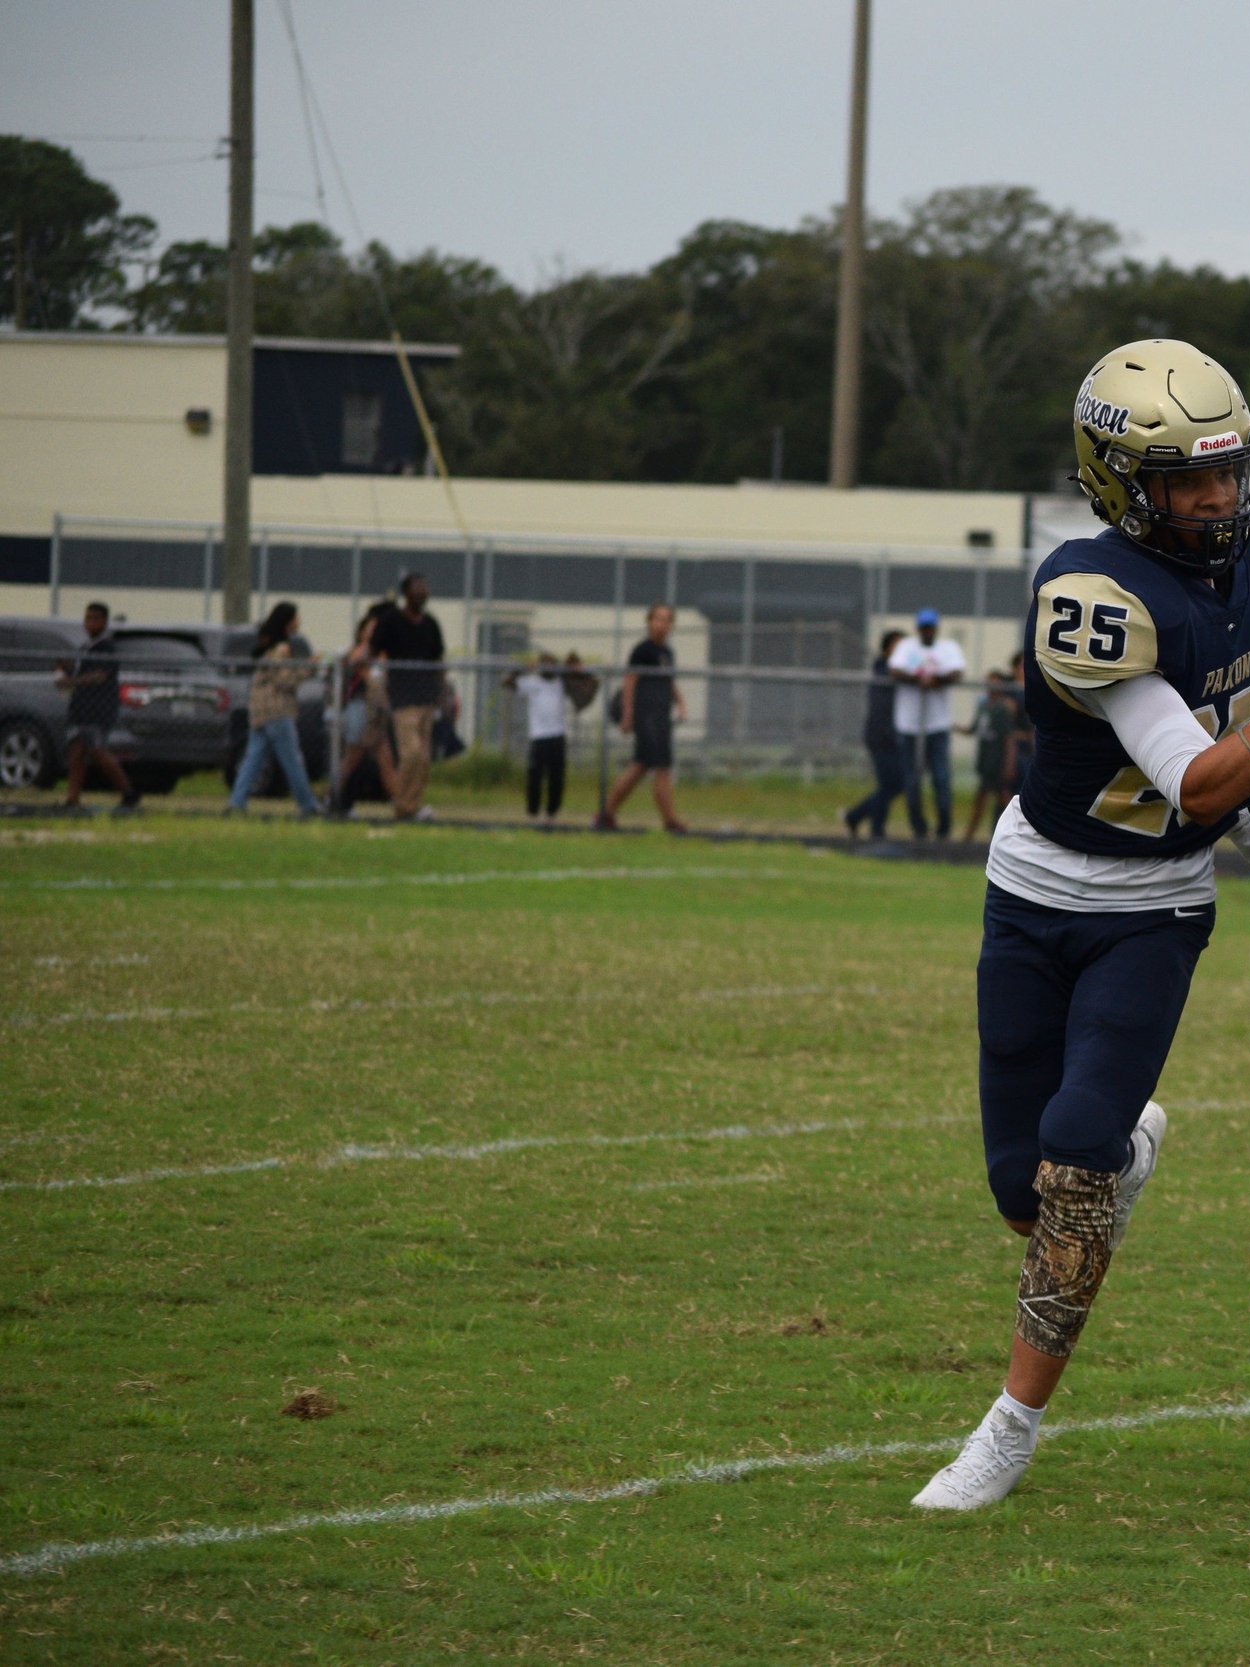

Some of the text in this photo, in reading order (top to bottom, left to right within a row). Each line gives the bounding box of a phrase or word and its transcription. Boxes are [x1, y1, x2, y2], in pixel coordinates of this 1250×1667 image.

[1077, 378, 1130, 436] Paxon
[1200, 435, 1238, 451] Riddell
[1048, 595, 1129, 663] 25
